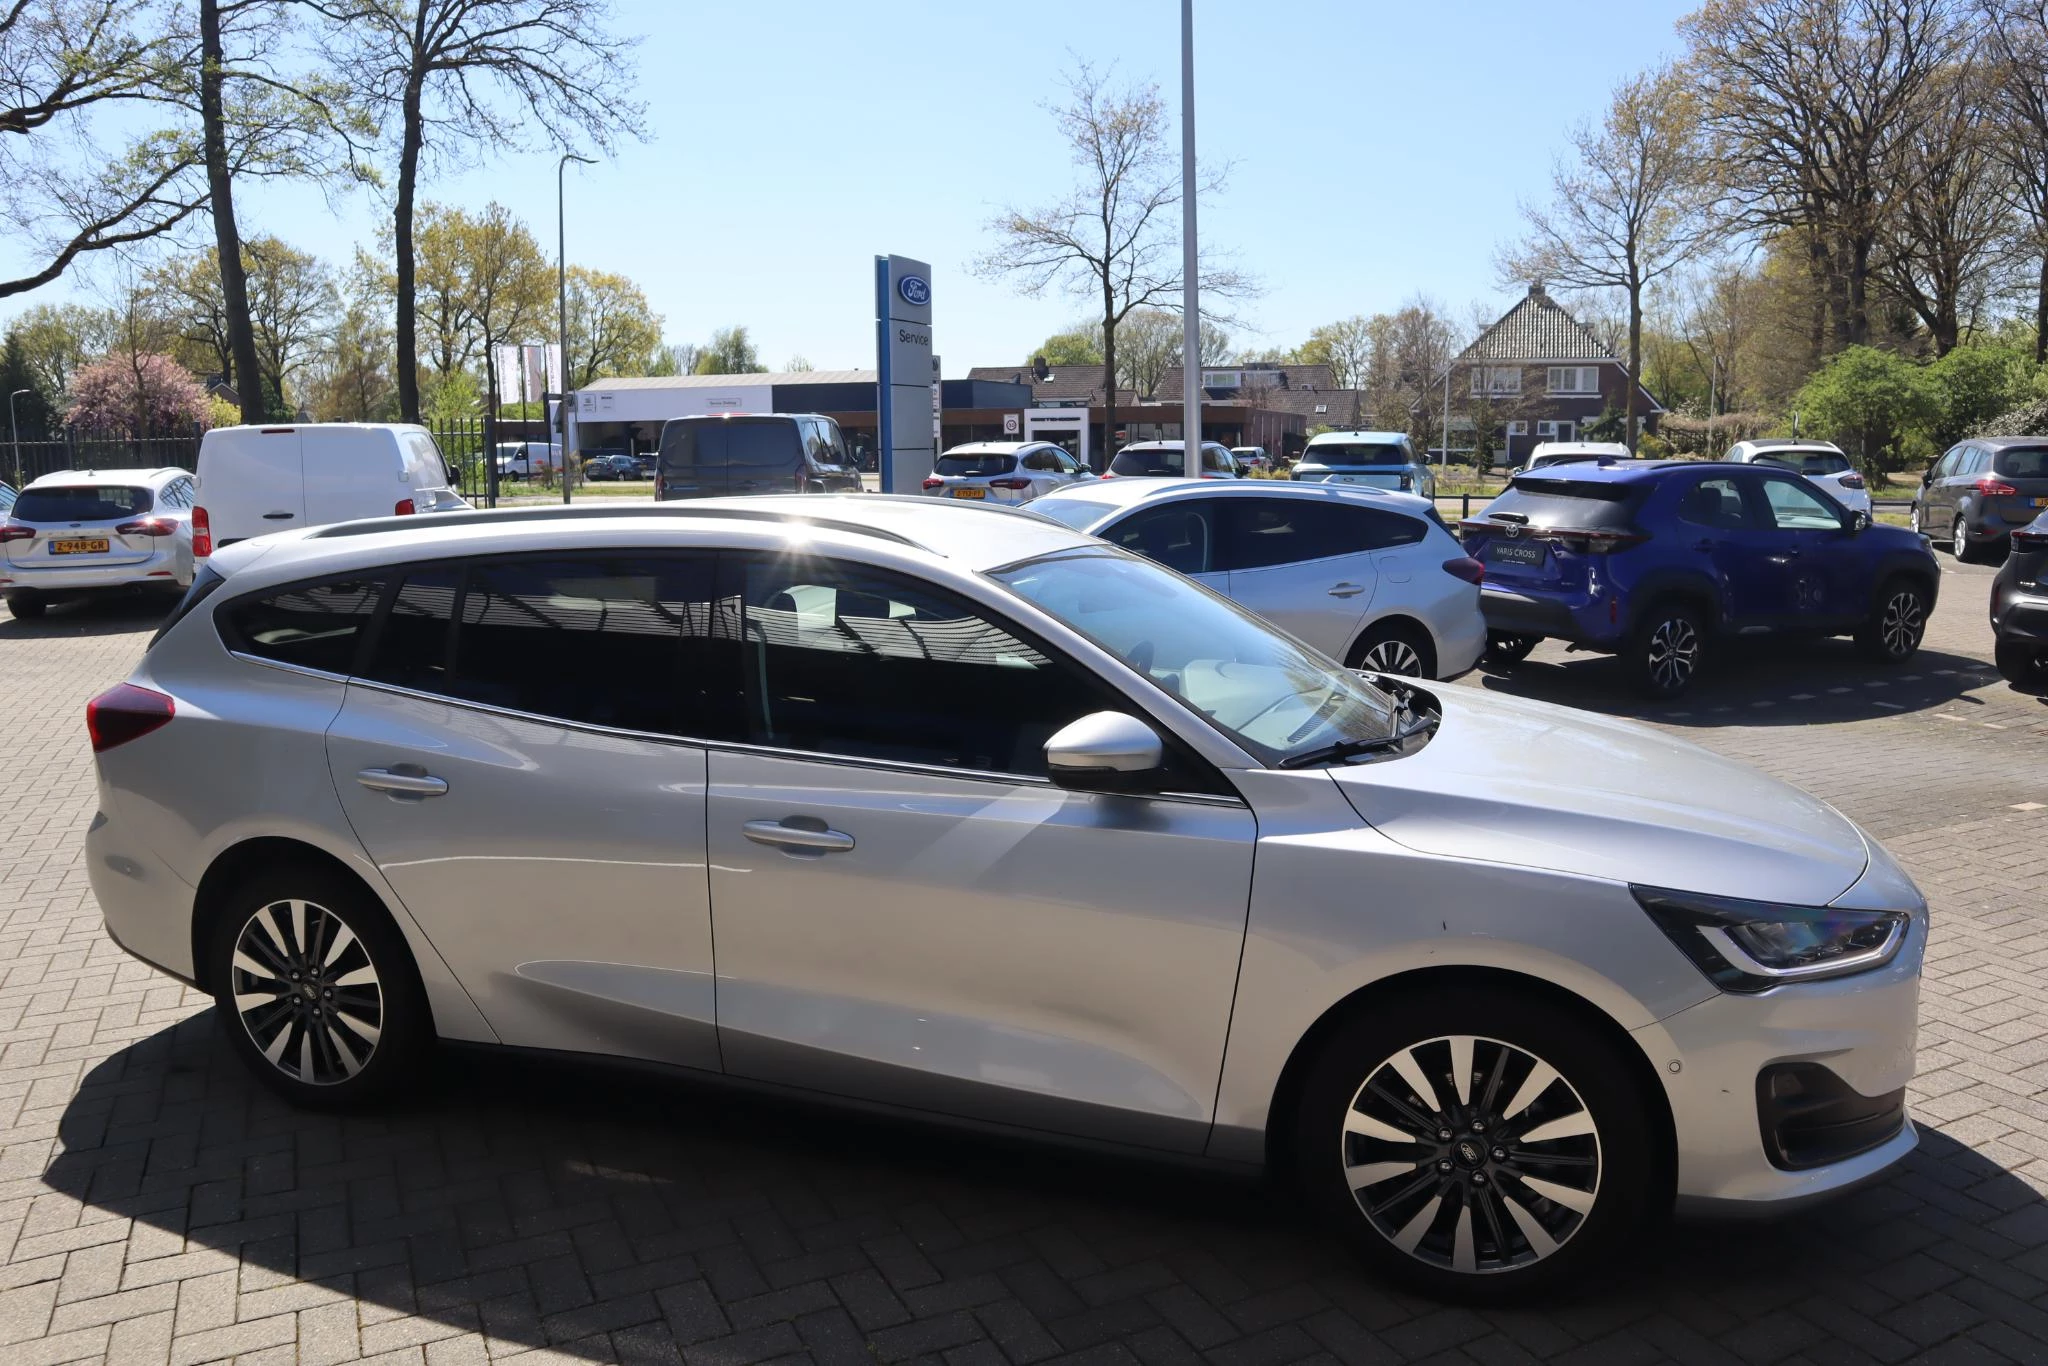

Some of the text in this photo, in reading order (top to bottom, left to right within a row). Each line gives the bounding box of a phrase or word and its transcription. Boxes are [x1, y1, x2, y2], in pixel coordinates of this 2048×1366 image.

[899, 328, 929, 346] Service
[1496, 547, 1536, 559] YARIS CROSS
